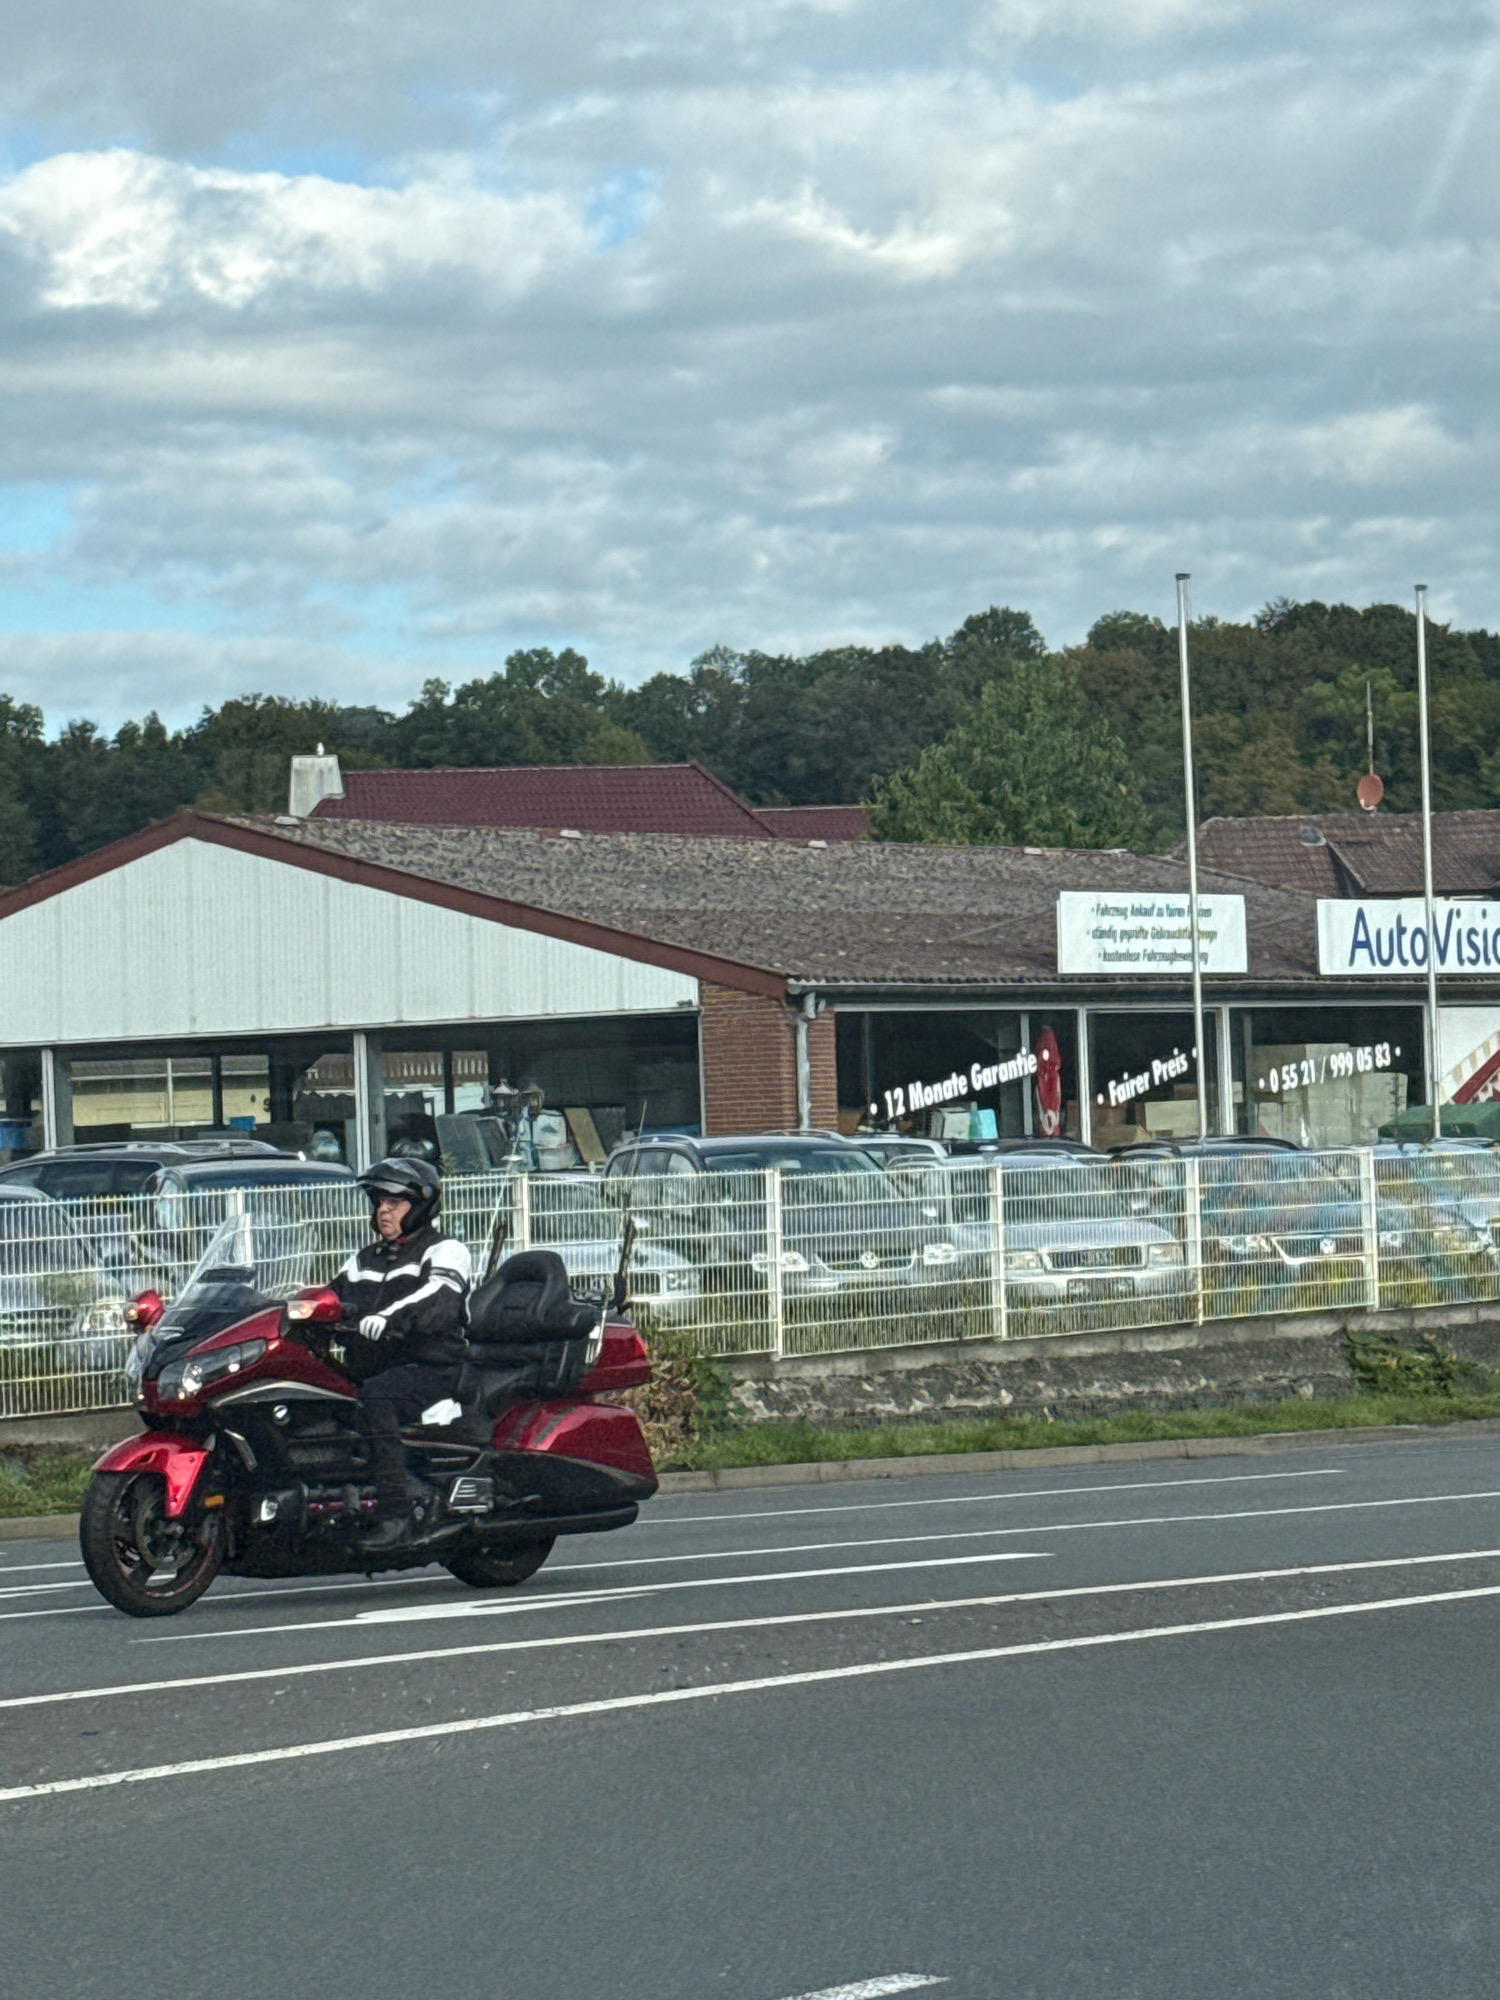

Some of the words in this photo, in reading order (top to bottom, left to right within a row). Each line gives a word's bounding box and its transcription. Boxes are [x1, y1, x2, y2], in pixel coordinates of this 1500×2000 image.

[1096, 903, 1128, 920] Fahrzeug
[1130, 903, 1155, 917] Ankauf
[1103, 948, 1141, 962] kostenlose
[884, 1087, 905, 1118] 12
[908, 1071, 968, 1112] Monate
[971, 1046, 1037, 1091] Garantie
[1108, 1071, 1150, 1107] Fairer
[1151, 1047, 1189, 1086] Preis
[1269, 1067, 1279, 1093] 0
[1281, 1063, 1298, 1091] 55
[1300, 1059, 1316, 1086] 21
[1330, 1051, 1353, 1079] 999
[1356, 1046, 1373, 1073] 05
[1375, 1042, 1391, 1069] 83
